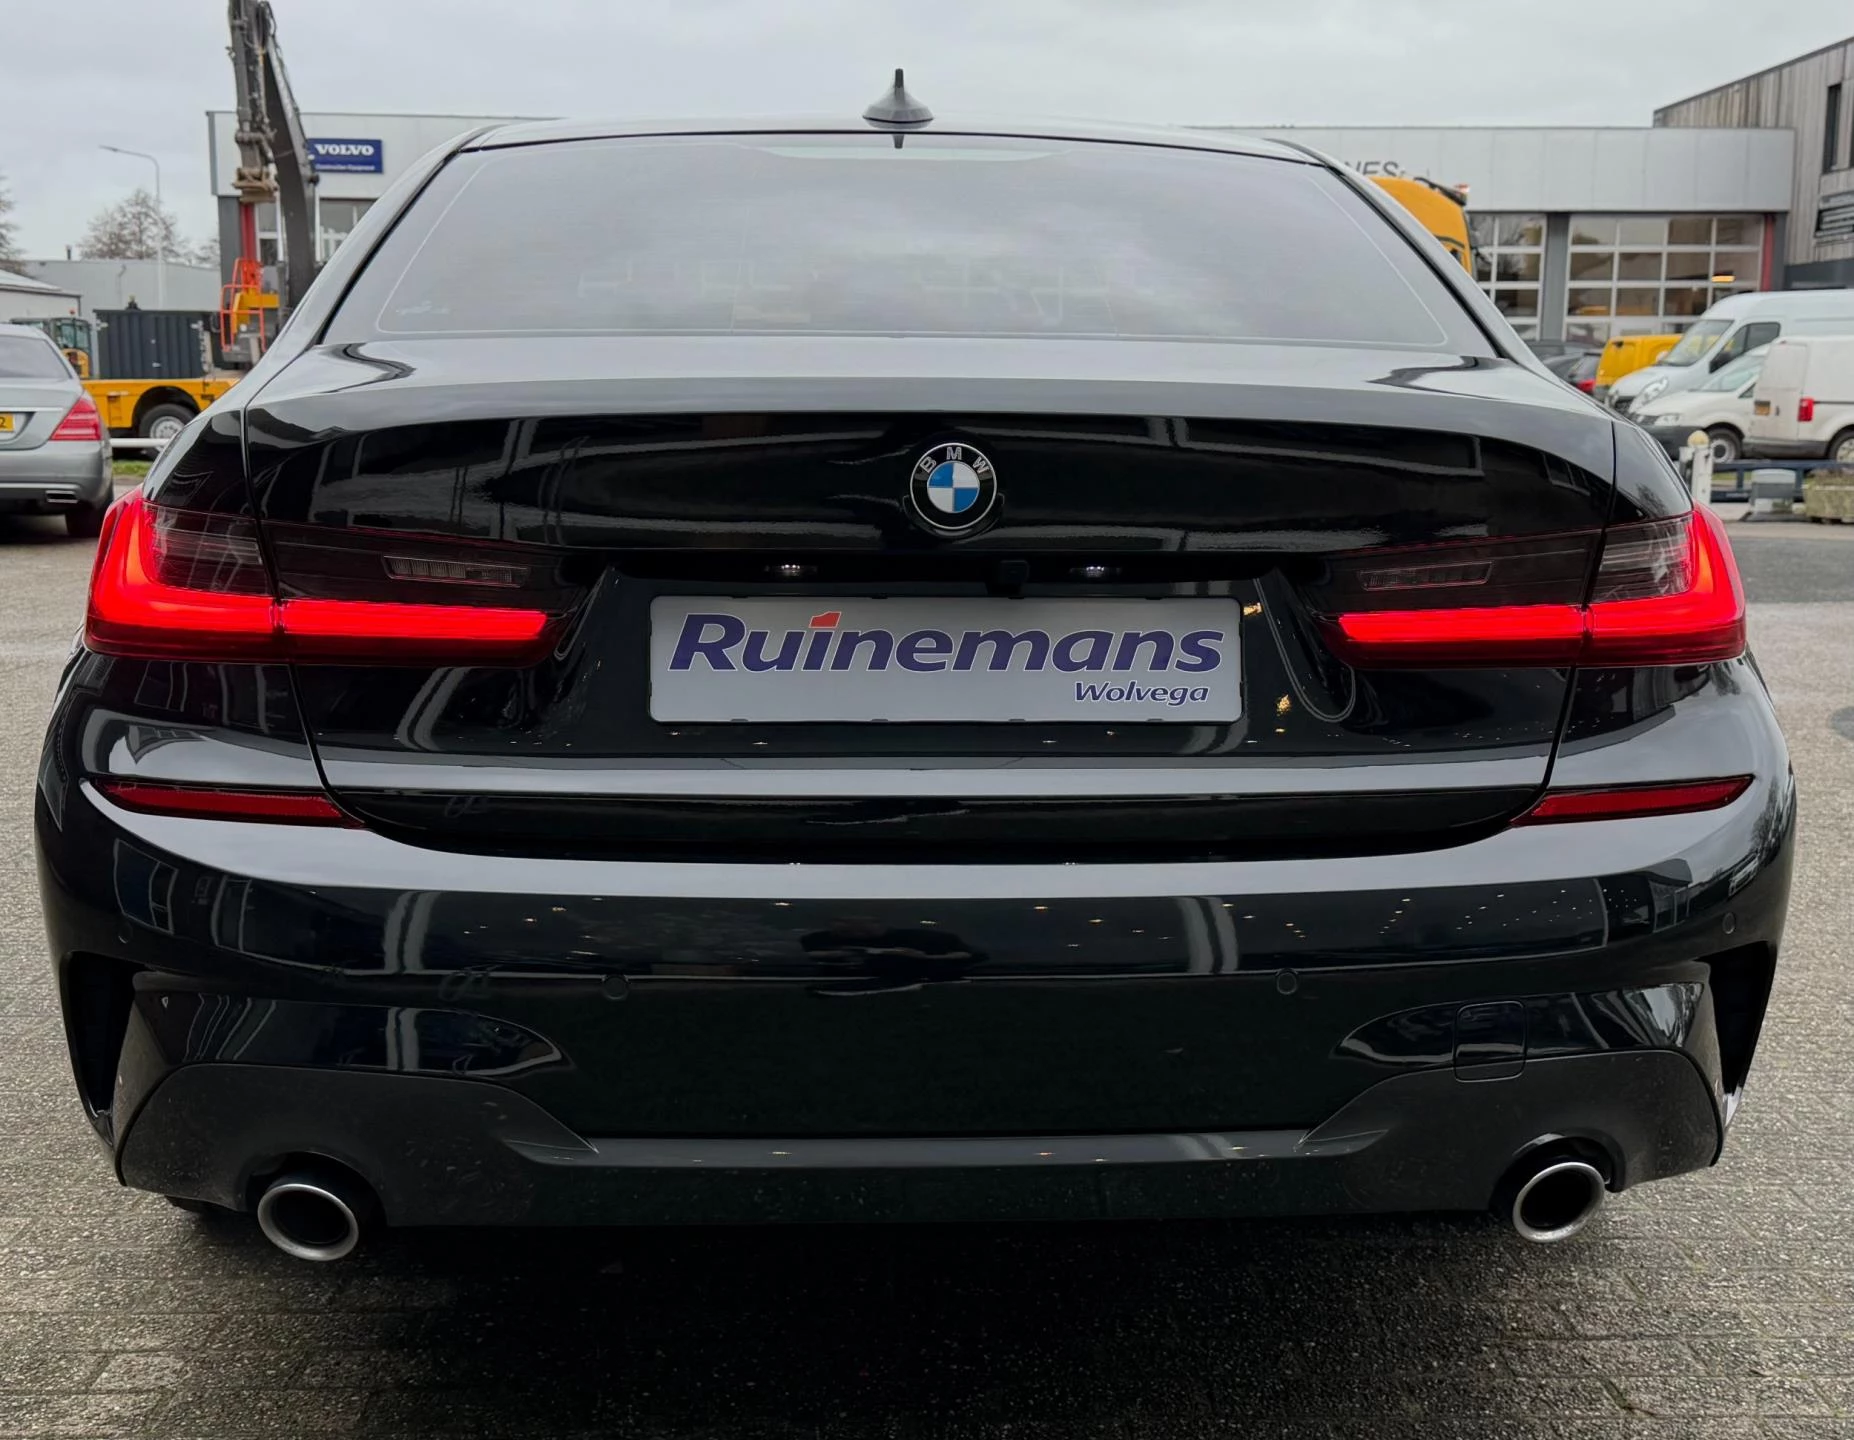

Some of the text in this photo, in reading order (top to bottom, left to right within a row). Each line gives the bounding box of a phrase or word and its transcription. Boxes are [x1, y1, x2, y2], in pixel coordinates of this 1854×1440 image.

[314, 144, 374, 156] VOLVO
[920, 447, 990, 473] BMW
[668, 611, 1224, 672] Ruinemans
[1074, 681, 1210, 707] Wolvega
